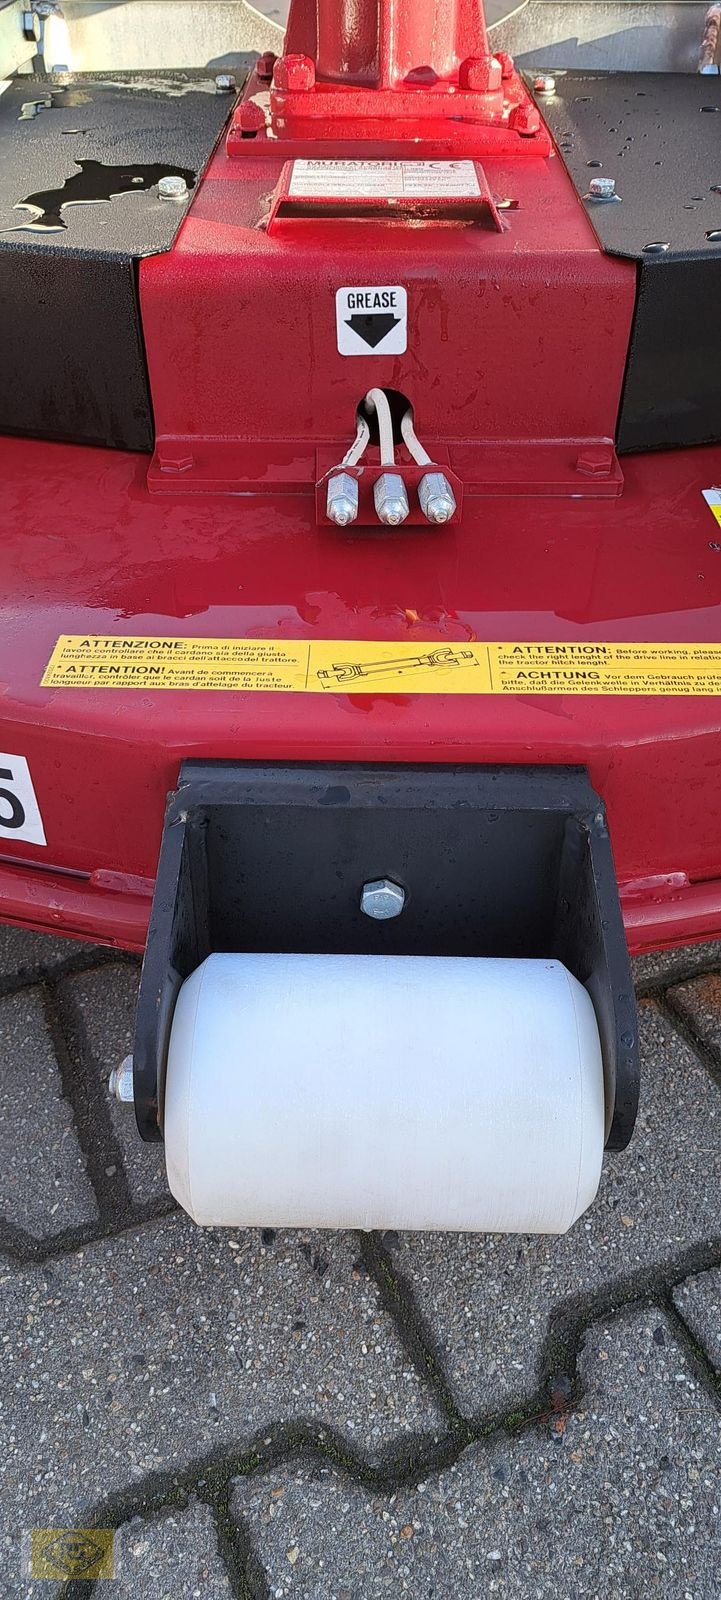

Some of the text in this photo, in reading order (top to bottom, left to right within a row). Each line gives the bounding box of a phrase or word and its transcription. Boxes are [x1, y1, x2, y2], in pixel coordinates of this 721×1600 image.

[347, 291, 397, 309] GREASE
[80, 640, 188, 649] ATTENZIONE:
[513, 646, 611, 654] ATTENTION:
[65, 665, 165, 674] ATTENTION!
[516, 671, 600, 679] ACHTUNG
[0, 767, 25, 829] 5
